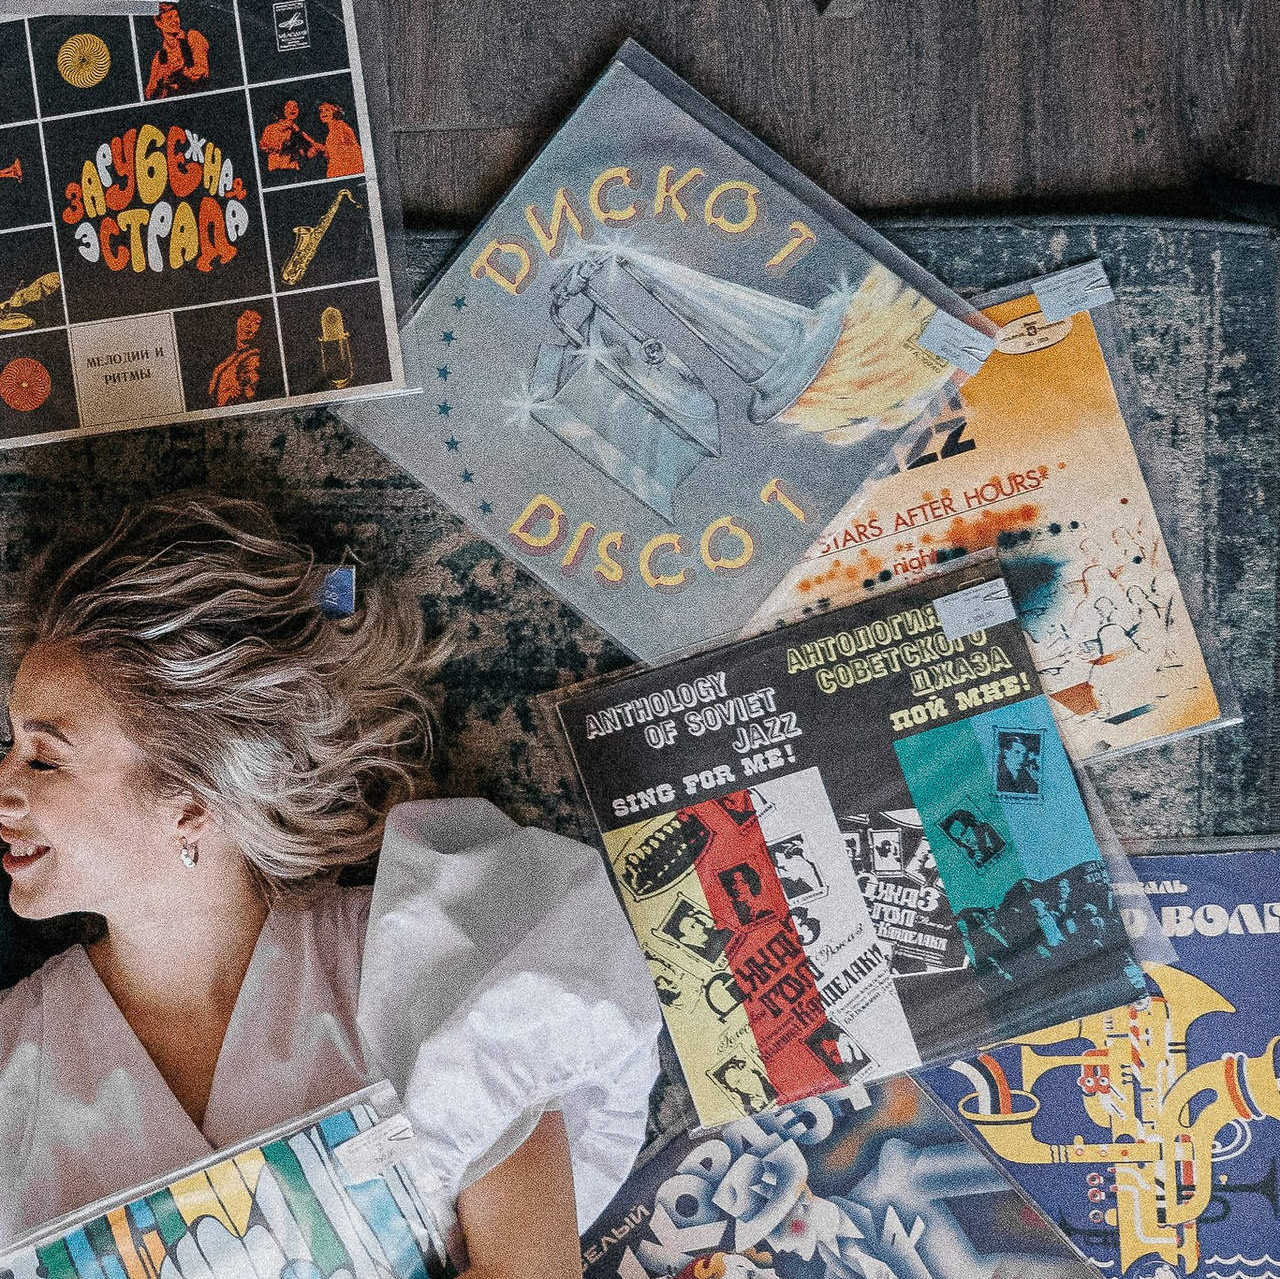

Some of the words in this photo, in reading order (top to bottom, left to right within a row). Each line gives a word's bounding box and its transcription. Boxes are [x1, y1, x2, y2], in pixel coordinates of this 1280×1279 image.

[62, 123, 248, 224] ЗАРУБЕЖНАЯ
[74, 199, 250, 274] ЭСТРАДА
[470, 163, 763, 296] ДИСКО
[86, 348, 149, 371] МЕЛОДИИ
[154, 345, 165, 358] И
[104, 367, 151, 384] РИТМЫ
[893, 496, 955, 536] AFTER
[964, 469, 1043, 511] HOURS
[507, 492, 758, 590] DISCO
[585, 670, 728, 740] ANTHOLOGY
[888, 694, 947, 732] ПОЙ
[955, 670, 1032, 714] МНЕ!
[911, 651, 1014, 698] ДЖАЗА
[643, 718, 679, 750] OF
[685, 686, 778, 739] SOVIET
[731, 711, 803, 756] JAZZ
[611, 780, 677, 818] SING
[682, 764, 736, 796] FOR
[740, 744, 797, 781] ME!
